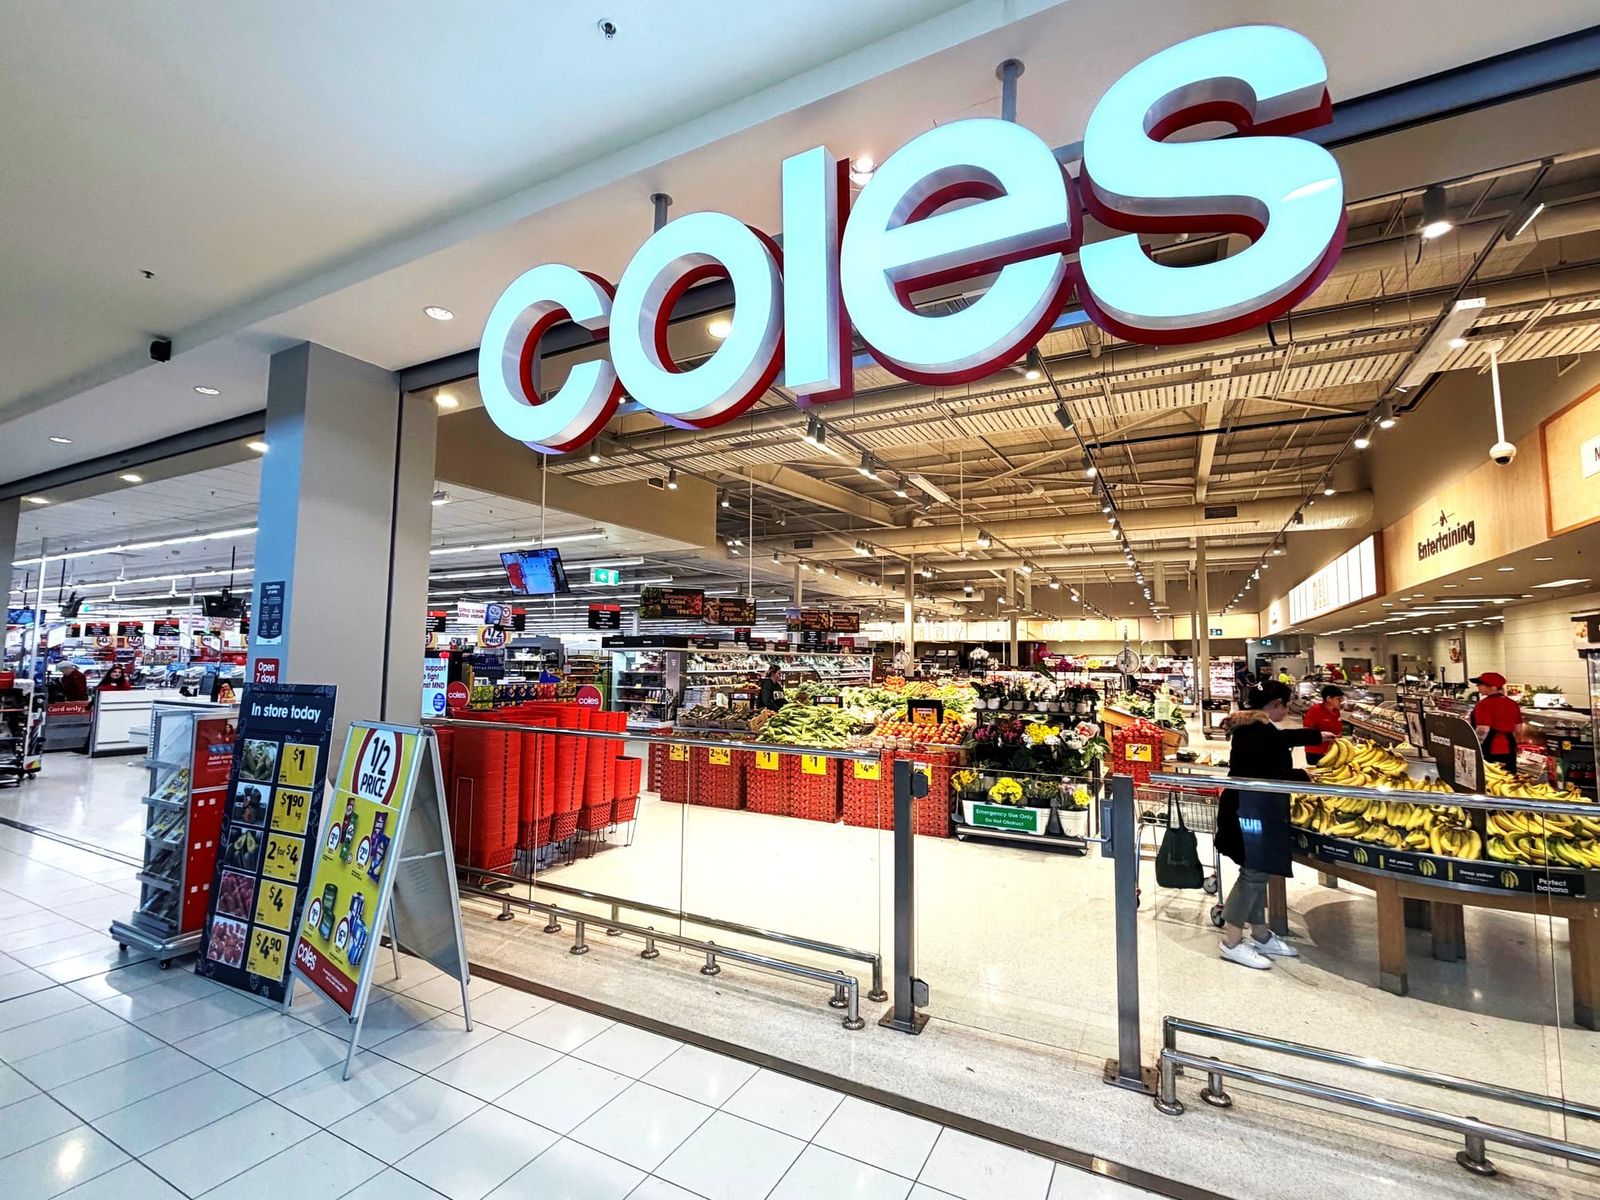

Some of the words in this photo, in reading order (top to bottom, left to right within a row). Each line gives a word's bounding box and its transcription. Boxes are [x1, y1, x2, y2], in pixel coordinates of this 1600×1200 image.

[478, 24, 1347, 453] coles
[1417, 520, 1476, 561] Entertaining
[258, 662, 275, 674] Open
[256, 673, 260, 682] 7
[260, 674, 276, 684] days
[448, 691, 466, 699] coles
[578, 696, 599, 705] coles
[66, 705, 82, 713] only
[251, 702, 260, 716] In
[263, 704, 288, 718] store
[290, 705, 321, 723] today
[670, 745, 676, 753] 2
[710, 749, 715, 757] 2
[293, 748, 305, 771] $1
[370, 736, 391, 777] 1/2
[762, 752, 770, 763] $1
[809, 755, 818, 767] $1
[360, 773, 387, 798] PRICE
[295, 810, 302, 821] kg
[975, 809, 1007, 818] Emergency
[1020, 813, 1033, 821] Only
[267, 841, 277, 860] 2
[285, 844, 299, 865] $4
[1537, 884, 1569, 893] banana
[1538, 878, 1567, 887] Perfect
[268, 886, 284, 912] $4
[298, 943, 317, 970] coles
